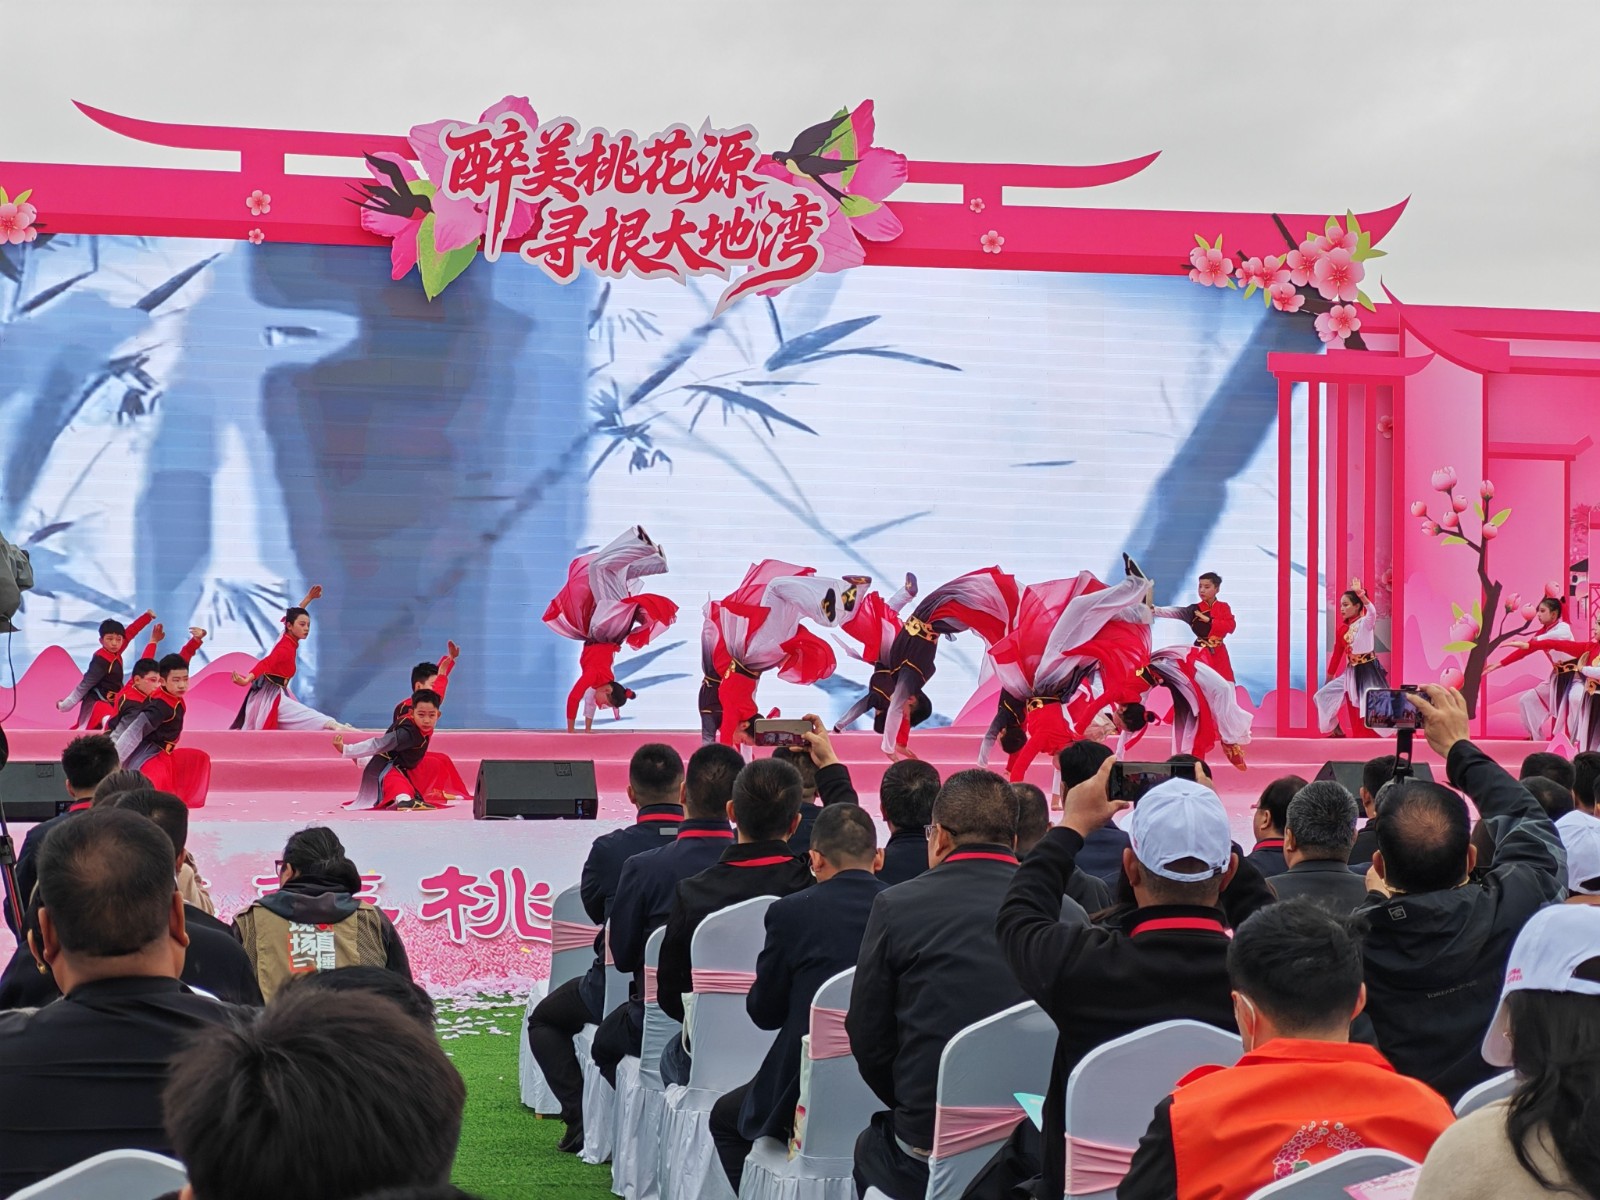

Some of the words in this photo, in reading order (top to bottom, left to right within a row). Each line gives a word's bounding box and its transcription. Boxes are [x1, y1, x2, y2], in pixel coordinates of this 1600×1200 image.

[446, 117, 769, 252] 醉美桃花源
[527, 193, 823, 301] 寻根大地湾
